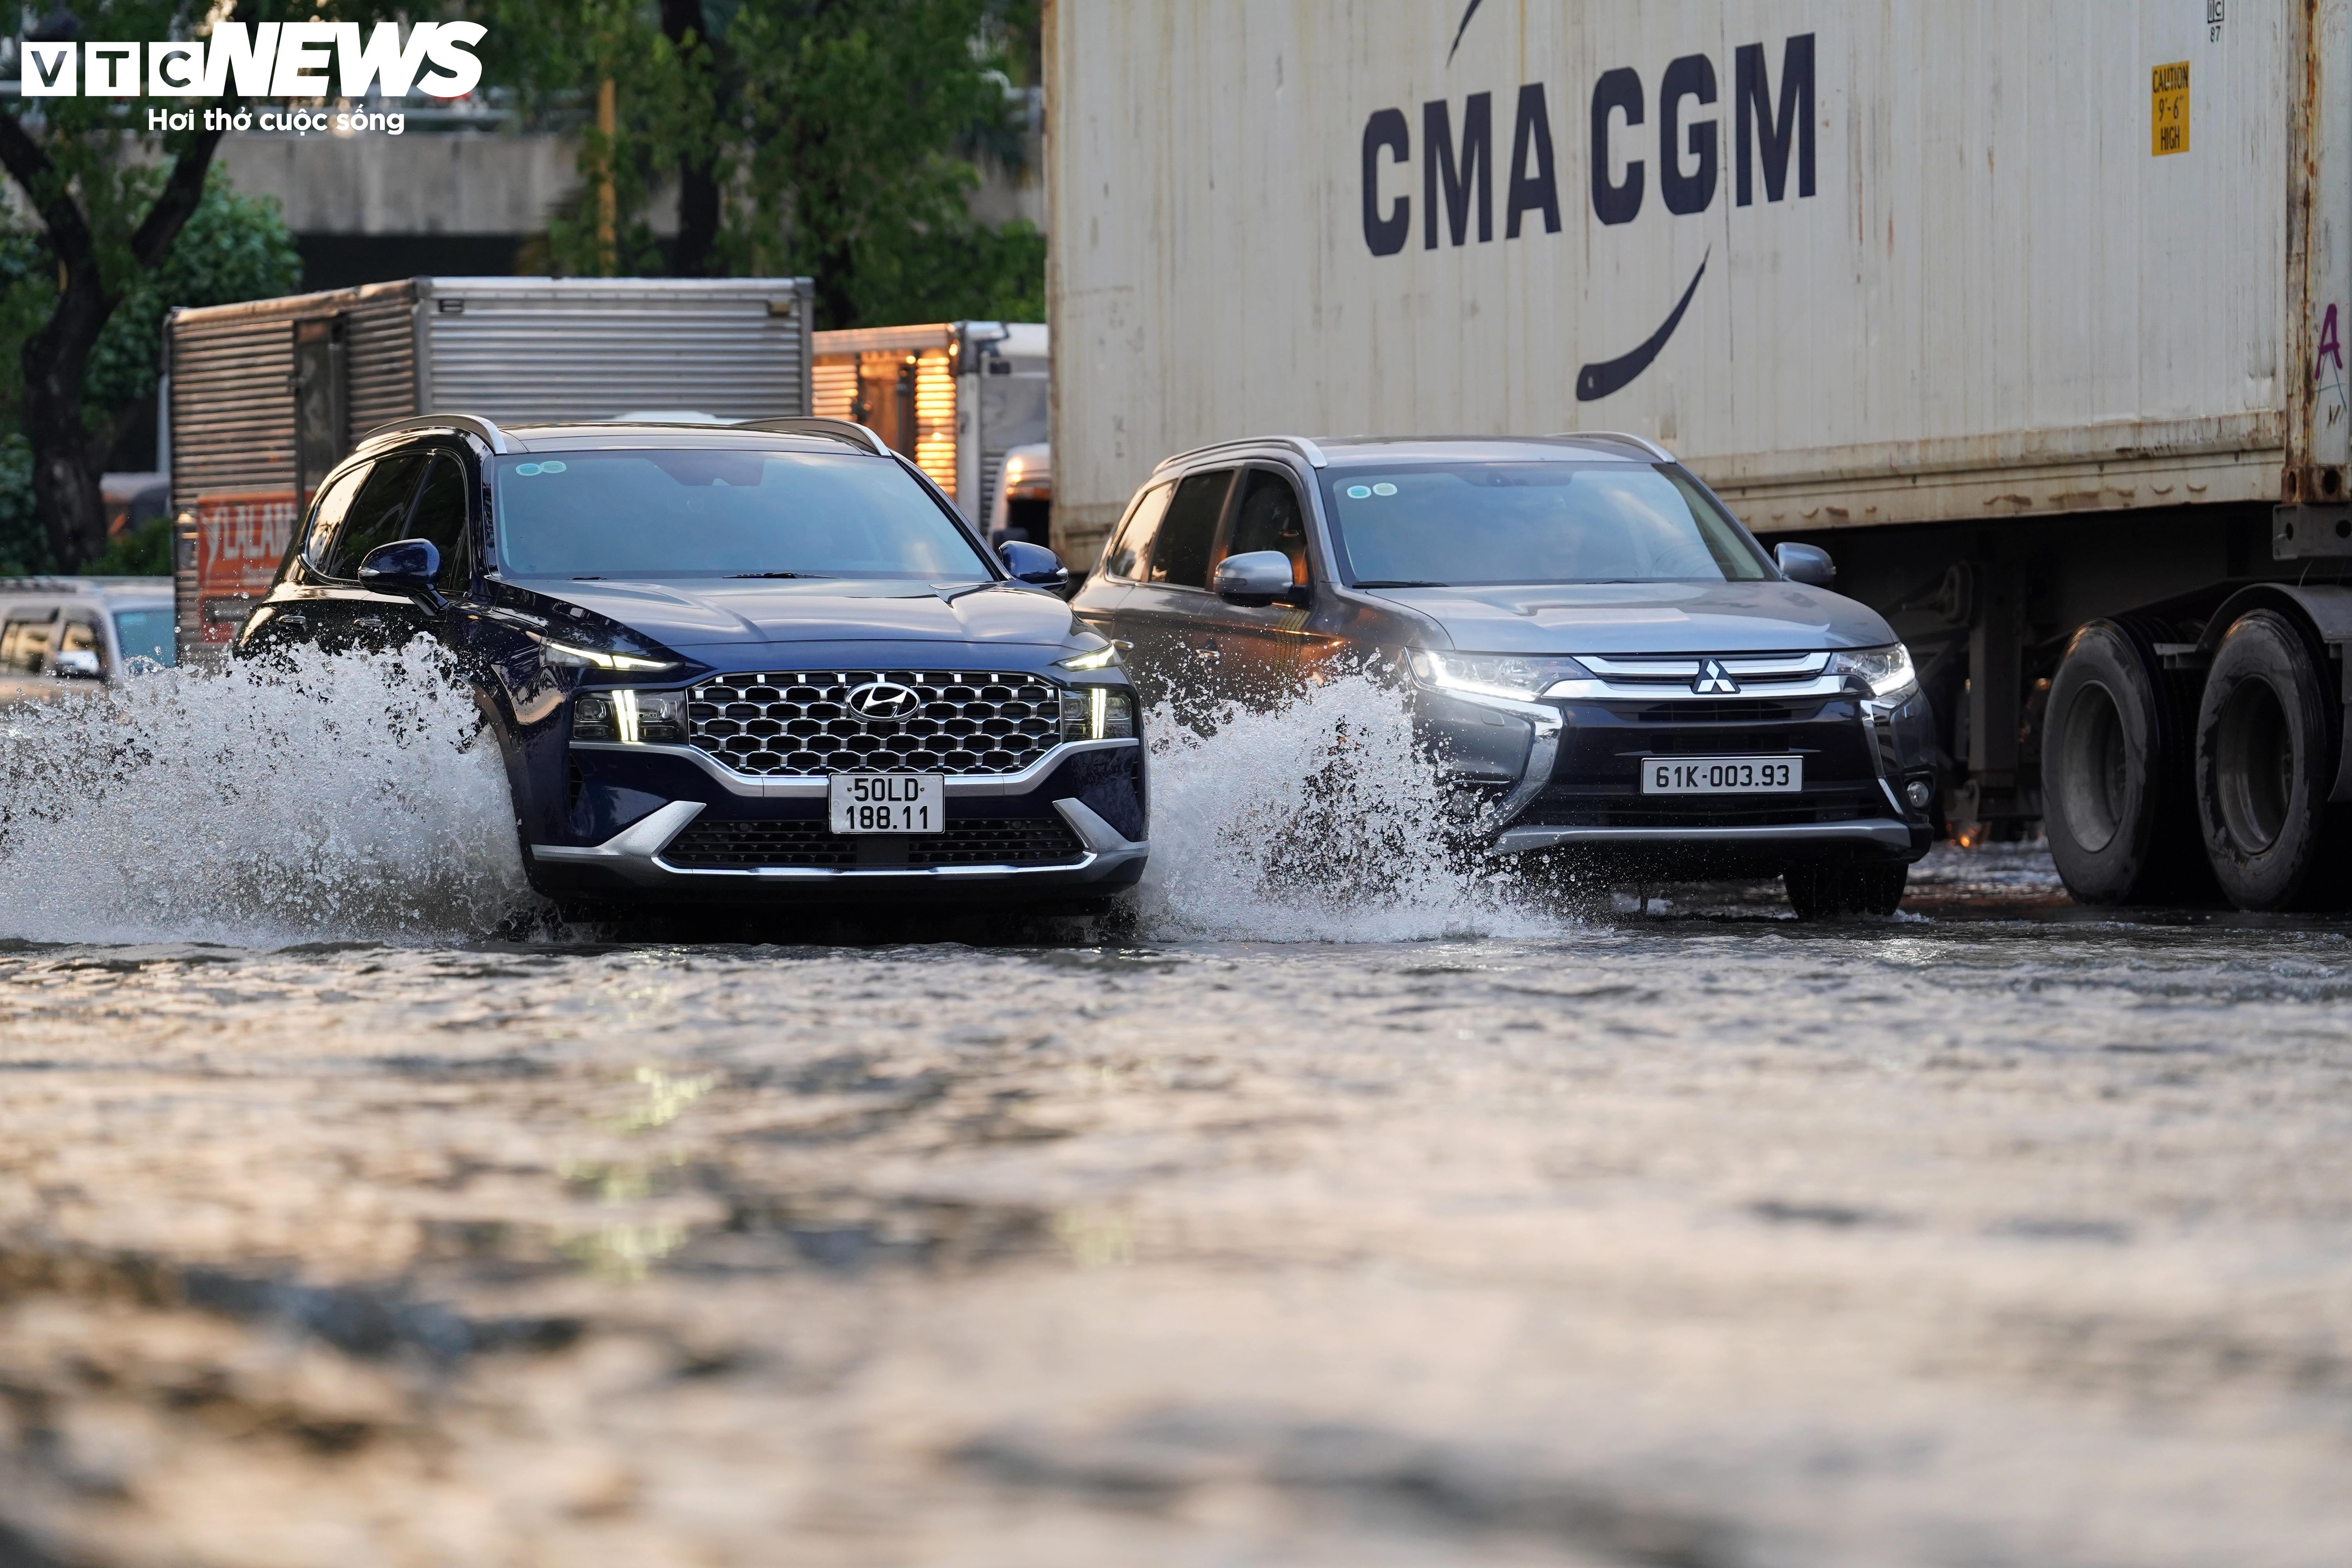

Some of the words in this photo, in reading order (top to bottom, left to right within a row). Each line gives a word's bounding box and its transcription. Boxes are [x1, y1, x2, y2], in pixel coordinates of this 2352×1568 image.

[2210, 25, 2220, 43] 87
[2152, 64, 2189, 93] CAUTION
[1362, 82, 1562, 257] CMA
[1591, 32, 1816, 226] CGM
[2160, 124, 2181, 151] HIGH
[1656, 764, 1789, 788] 61K-003.93
[854, 778, 918, 802] 50LD
[846, 806, 928, 829] 188.11
